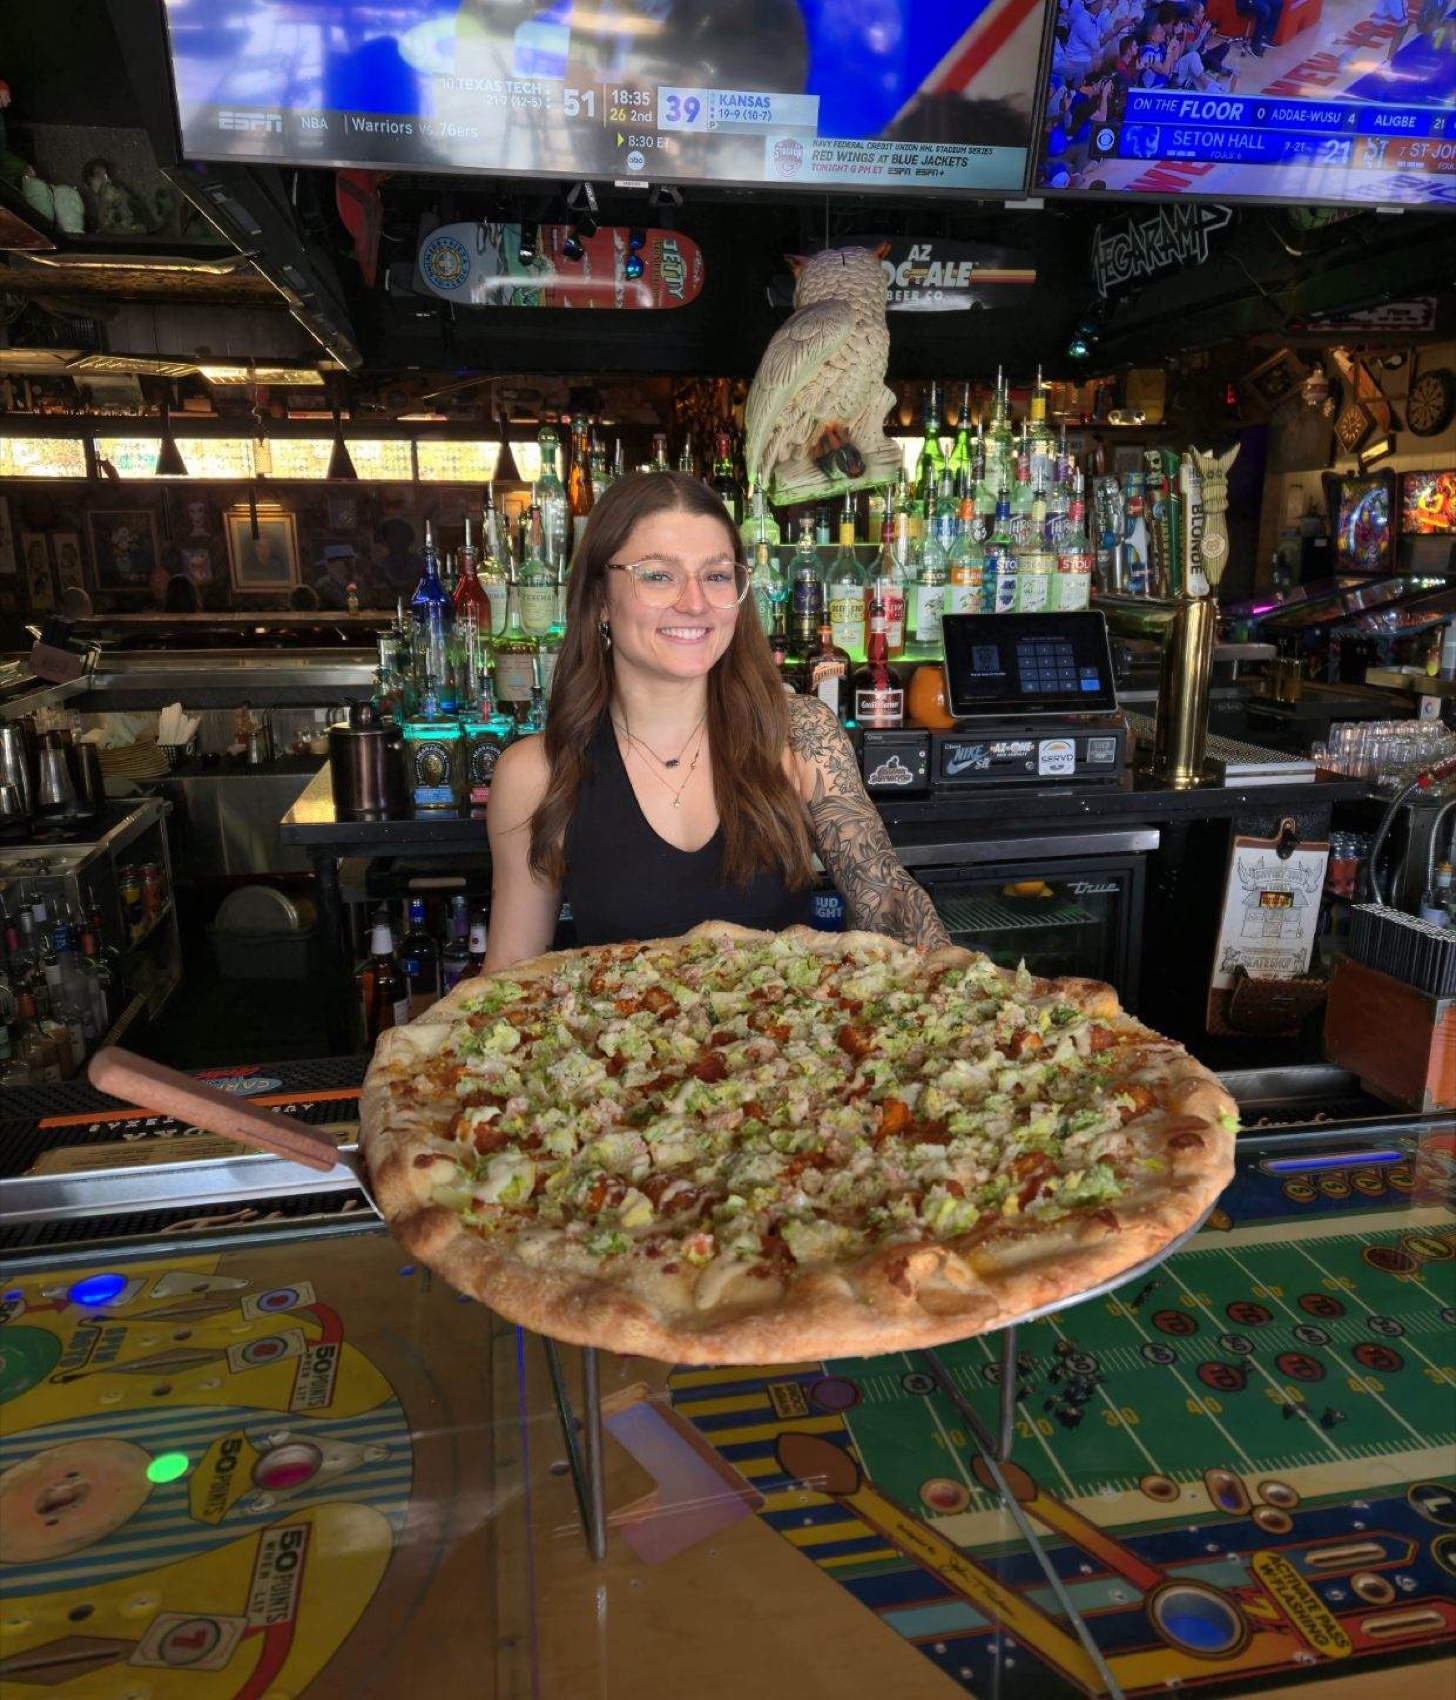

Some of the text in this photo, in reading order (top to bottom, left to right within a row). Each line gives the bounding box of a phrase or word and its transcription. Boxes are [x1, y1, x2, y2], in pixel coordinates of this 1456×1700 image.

[455, 79, 501, 92] TEXAS
[505, 81, 541, 94] TECH
[563, 89, 595, 117] 51
[612, 90, 651, 106] 18:35
[718, 94, 771, 108] KANSAS
[610, 108, 653, 122] 26 2nd
[665, 95, 701, 123] 39
[718, 109, 772, 123] 19-9 (10-7)
[1133, 98, 1244, 121] ON THE FLOOR
[218, 111, 283, 133] ESPN
[301, 116, 329, 131] NBA
[351, 119, 479, 138] Warriors vs 76ers
[1374, 115, 1417, 128] ALIGBE
[628, 135, 654, 149] 8:30
[1173, 130, 1266, 150] SETON HALL
[813, 150, 969, 167] RED WINGS AT BLUE JACKETS
[1410, 143, 1431, 157] ST
[908, 244, 933, 261] AZ
[887, 290, 919, 300] BEER
[1191, 504, 1202, 575] BLONDE
[955, 744, 984, 761] NIKE
[313, 1345, 336, 1373] 50
[1106, 1407, 1140, 1428] 30
[1016, 1417, 1055, 1438] 20
[932, 1428, 967, 1448] 10
[203, 1438, 244, 1515] 50 POINTS
[262, 1541, 277, 1582] WHEN
[266, 1530, 302, 1624] 50 POINTS
[1268, 1553, 1349, 1649] ACTIVATE PASS
